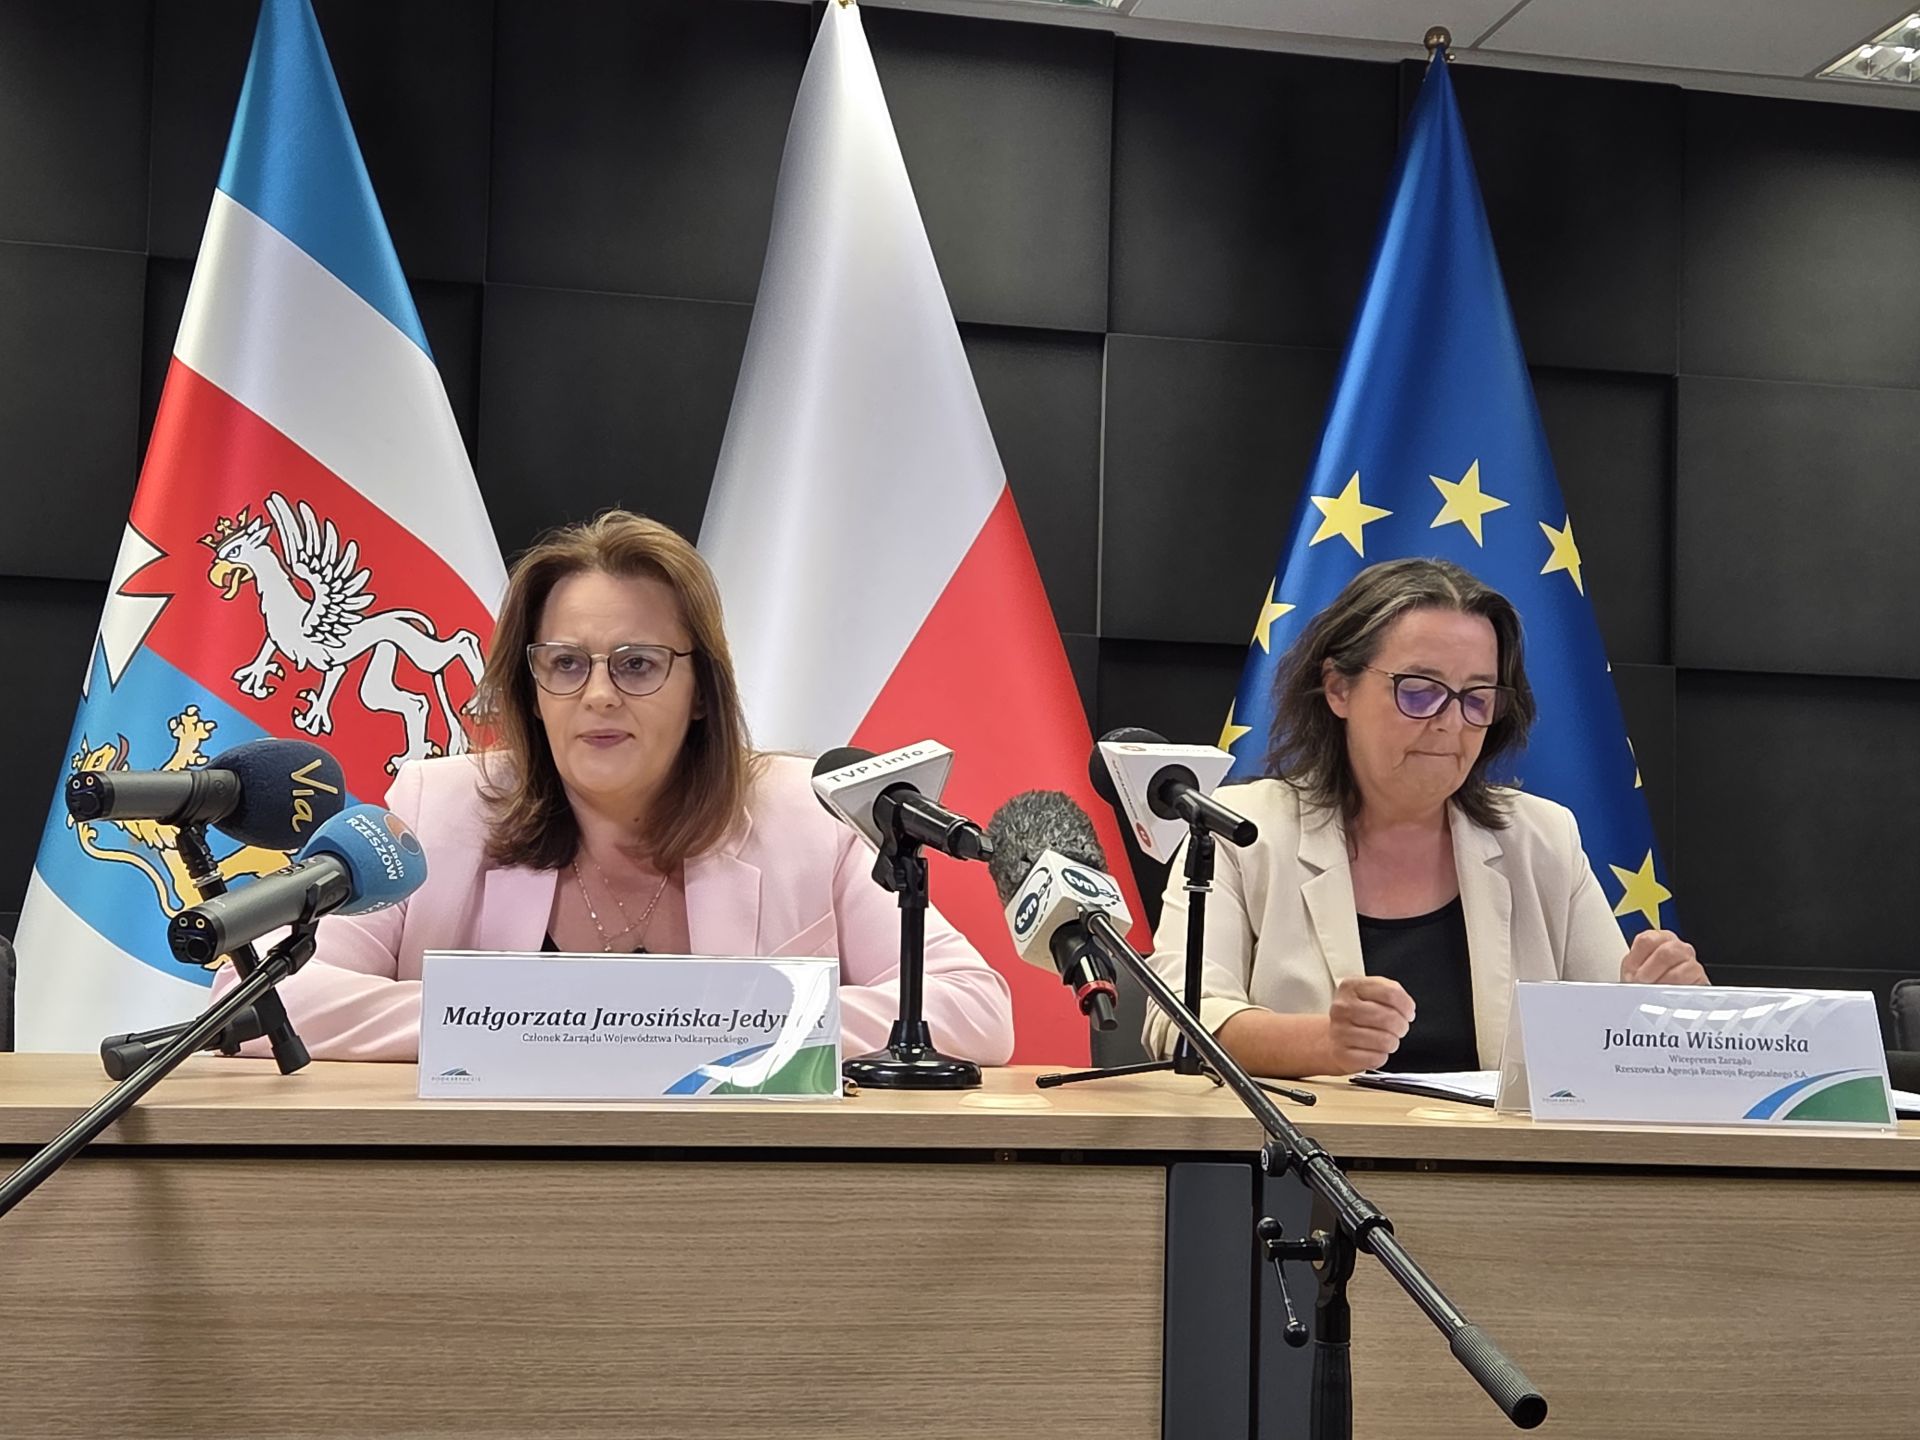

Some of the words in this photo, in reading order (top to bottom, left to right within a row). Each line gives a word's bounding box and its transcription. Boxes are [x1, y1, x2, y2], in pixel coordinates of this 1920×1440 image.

[827, 765, 869, 783] TVP
[290, 758, 338, 833] Via
[345, 817, 398, 881] RZESZÓW
[355, 813, 389, 843] Polskie
[387, 844, 405, 878] Radio
[1064, 871, 1097, 893] tvn
[1016, 898, 1038, 929] tvn
[442, 1006, 587, 1031] Małgorzata
[589, 1007, 825, 1033] Jarosińska-Jedyk
[522, 1033, 561, 1043] Członek
[562, 1034, 601, 1045] Zarządu
[603, 1034, 672, 1044] Województwa
[674, 1034, 749, 1045] Podkarpackiego
[1602, 1028, 1680, 1050] Jolanta
[1685, 1031, 1809, 1053] Wiśniowska
[1615, 1064, 1665, 1074] Rzeszowska
[1666, 1066, 1699, 1077] Agencja
[1737, 1068, 1793, 1079] Regionalnego
[1668, 1054, 1717, 1065] Wiceprezes
